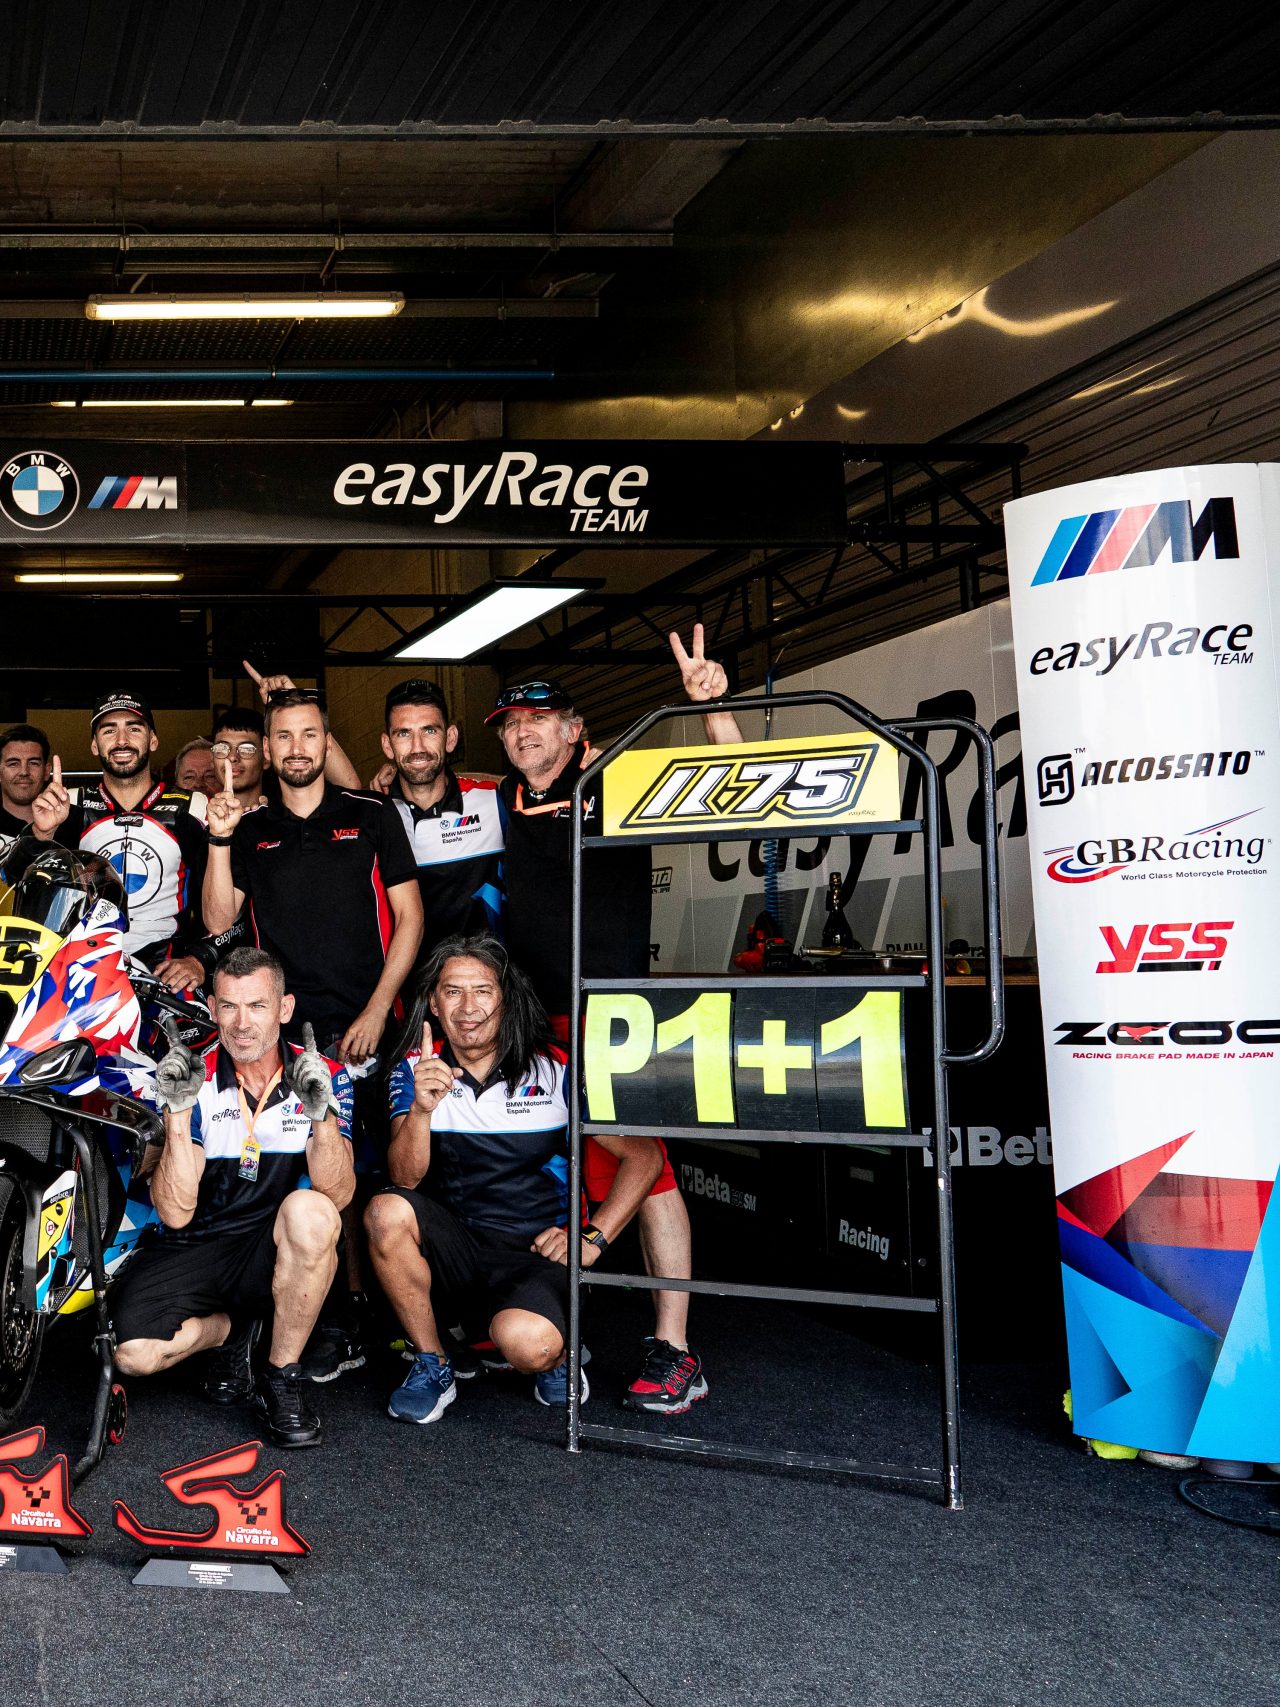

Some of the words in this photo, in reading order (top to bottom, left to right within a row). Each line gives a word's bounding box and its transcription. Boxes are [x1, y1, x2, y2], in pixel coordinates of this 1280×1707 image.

[333, 451, 649, 524] easyRace
[569, 508, 649, 532] TEAM
[1029, 621, 1253, 676] easyRace
[1213, 652, 1254, 665] TEAM
[1081, 750, 1252, 787] ACCOSSATO
[1077, 831, 1265, 865] GBRacing
[1121, 873, 1146, 881] World
[1148, 872, 1173, 880] Class
[1175, 869, 1224, 879] Motorcycle
[1226, 868, 1268, 876] Protection
[1096, 921, 1235, 974] YSS
[1238, 1051, 1274, 1059] JAPAN
[506, 1106, 530, 1115] España
[523, 1099, 552, 1107] Motorrad
[969, 1126, 1052, 1166] Bet
[839, 1218, 890, 1261] Racing
[11, 1513, 61, 1528] Navarra
[21, 1509, 45, 1517] Circuito
[236, 1526, 262, 1535] Circuito
[225, 1531, 279, 1546] Navarra
